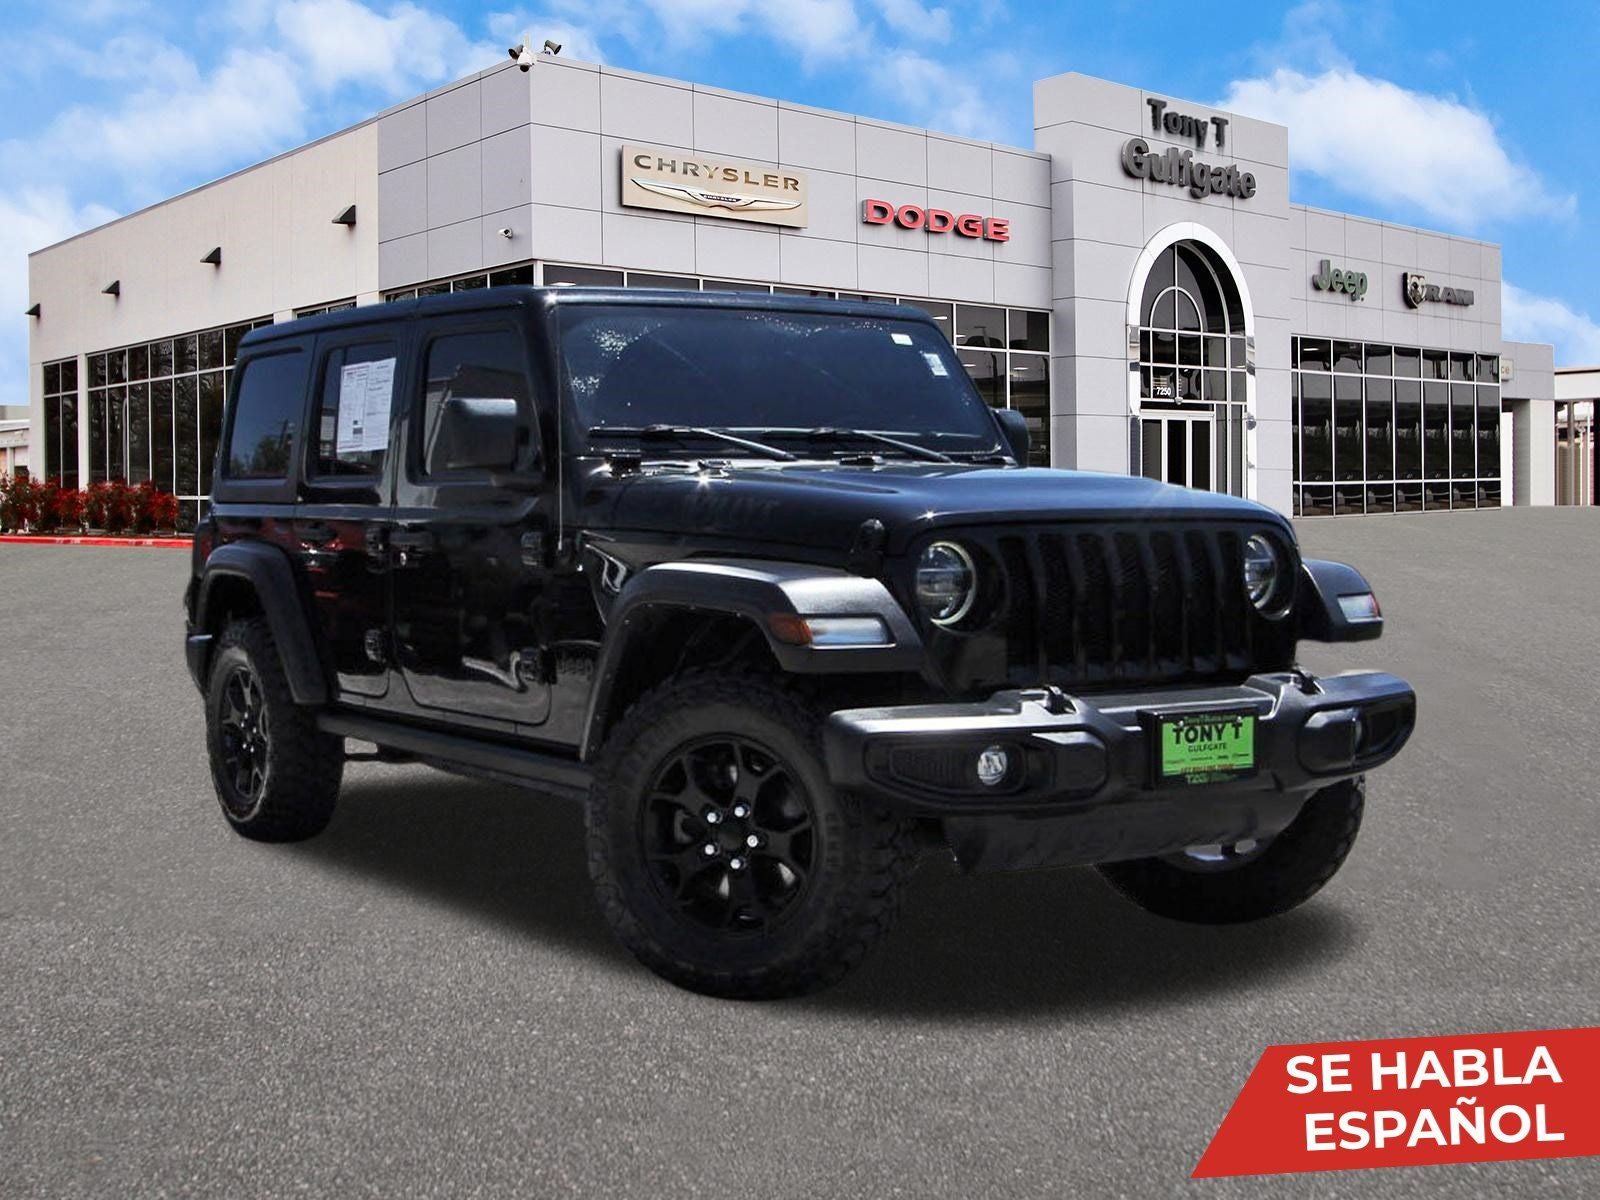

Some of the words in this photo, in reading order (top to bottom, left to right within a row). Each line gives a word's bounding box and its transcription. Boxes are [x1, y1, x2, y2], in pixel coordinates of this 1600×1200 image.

[1147, 98, 1209, 148] Tony
[1210, 116, 1229, 148] T
[633, 154, 800, 192] CHRYSLER
[1121, 138, 1257, 199] Gulfgate
[862, 199, 1010, 242] DODGE
[1312, 259, 1368, 302] Jeep
[1424, 284, 1475, 306] RAM
[1156, 386, 1172, 396] 7250
[1172, 723, 1227, 745] TONY
[1231, 721, 1243, 740] T
[1188, 742, 1228, 753] GULFGATE
